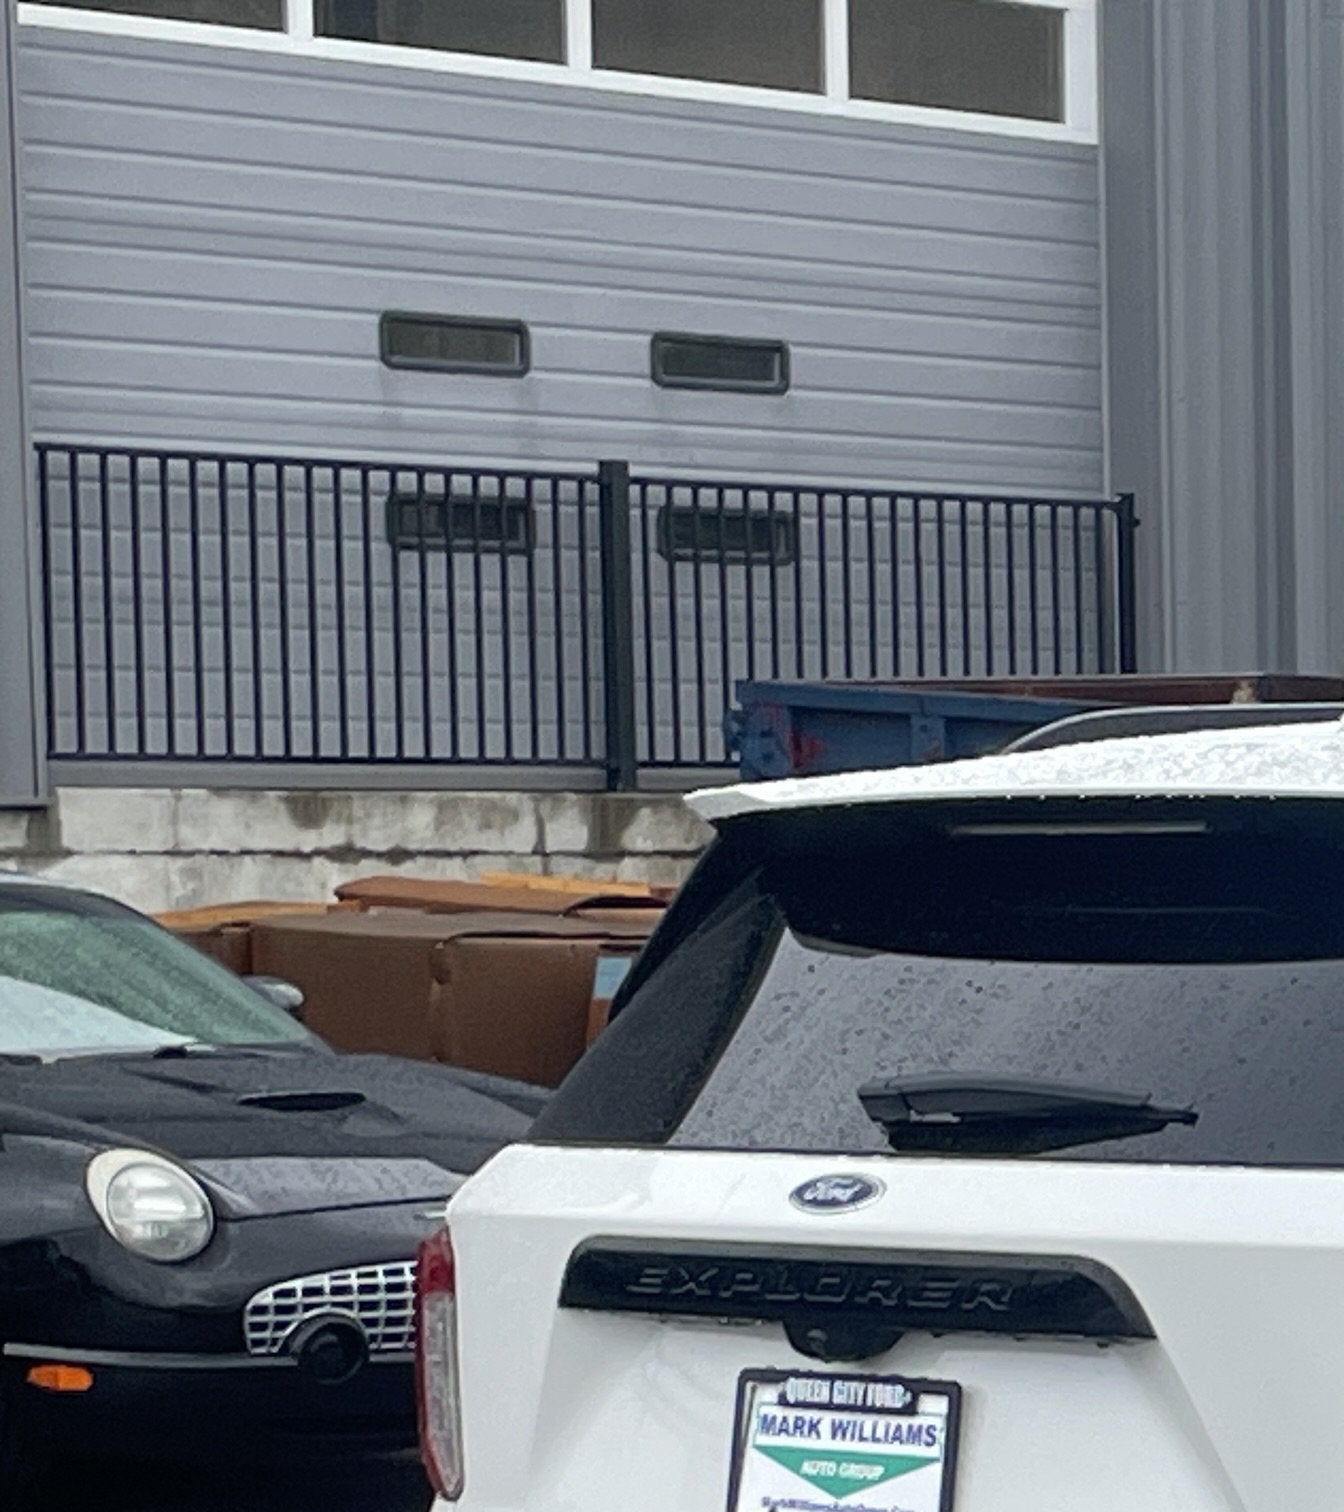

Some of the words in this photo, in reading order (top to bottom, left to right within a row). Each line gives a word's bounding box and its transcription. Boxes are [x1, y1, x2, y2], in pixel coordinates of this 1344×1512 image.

[625, 1265, 1013, 1311] EXPLORER
[759, 1413, 822, 1439] MARK
[830, 1419, 938, 1447] WILLIAMS
[800, 1460, 837, 1477] AUTO
[839, 1462, 885, 1480] GROUP
